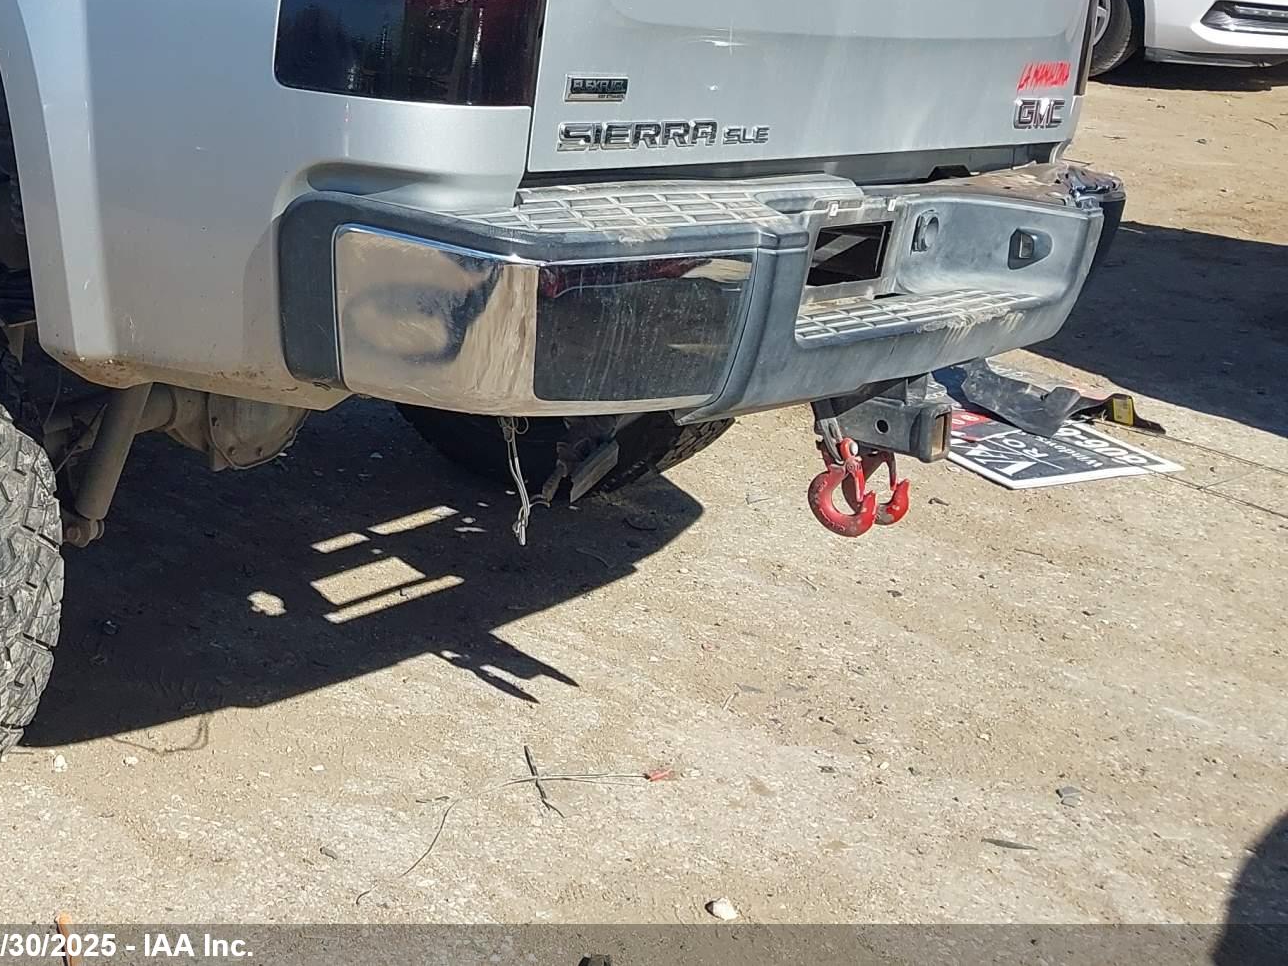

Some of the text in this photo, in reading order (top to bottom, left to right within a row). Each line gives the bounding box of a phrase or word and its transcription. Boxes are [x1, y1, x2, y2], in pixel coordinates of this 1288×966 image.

[1014, 98, 1065, 129] GMC
[557, 119, 770, 151] SIERRA SLE
